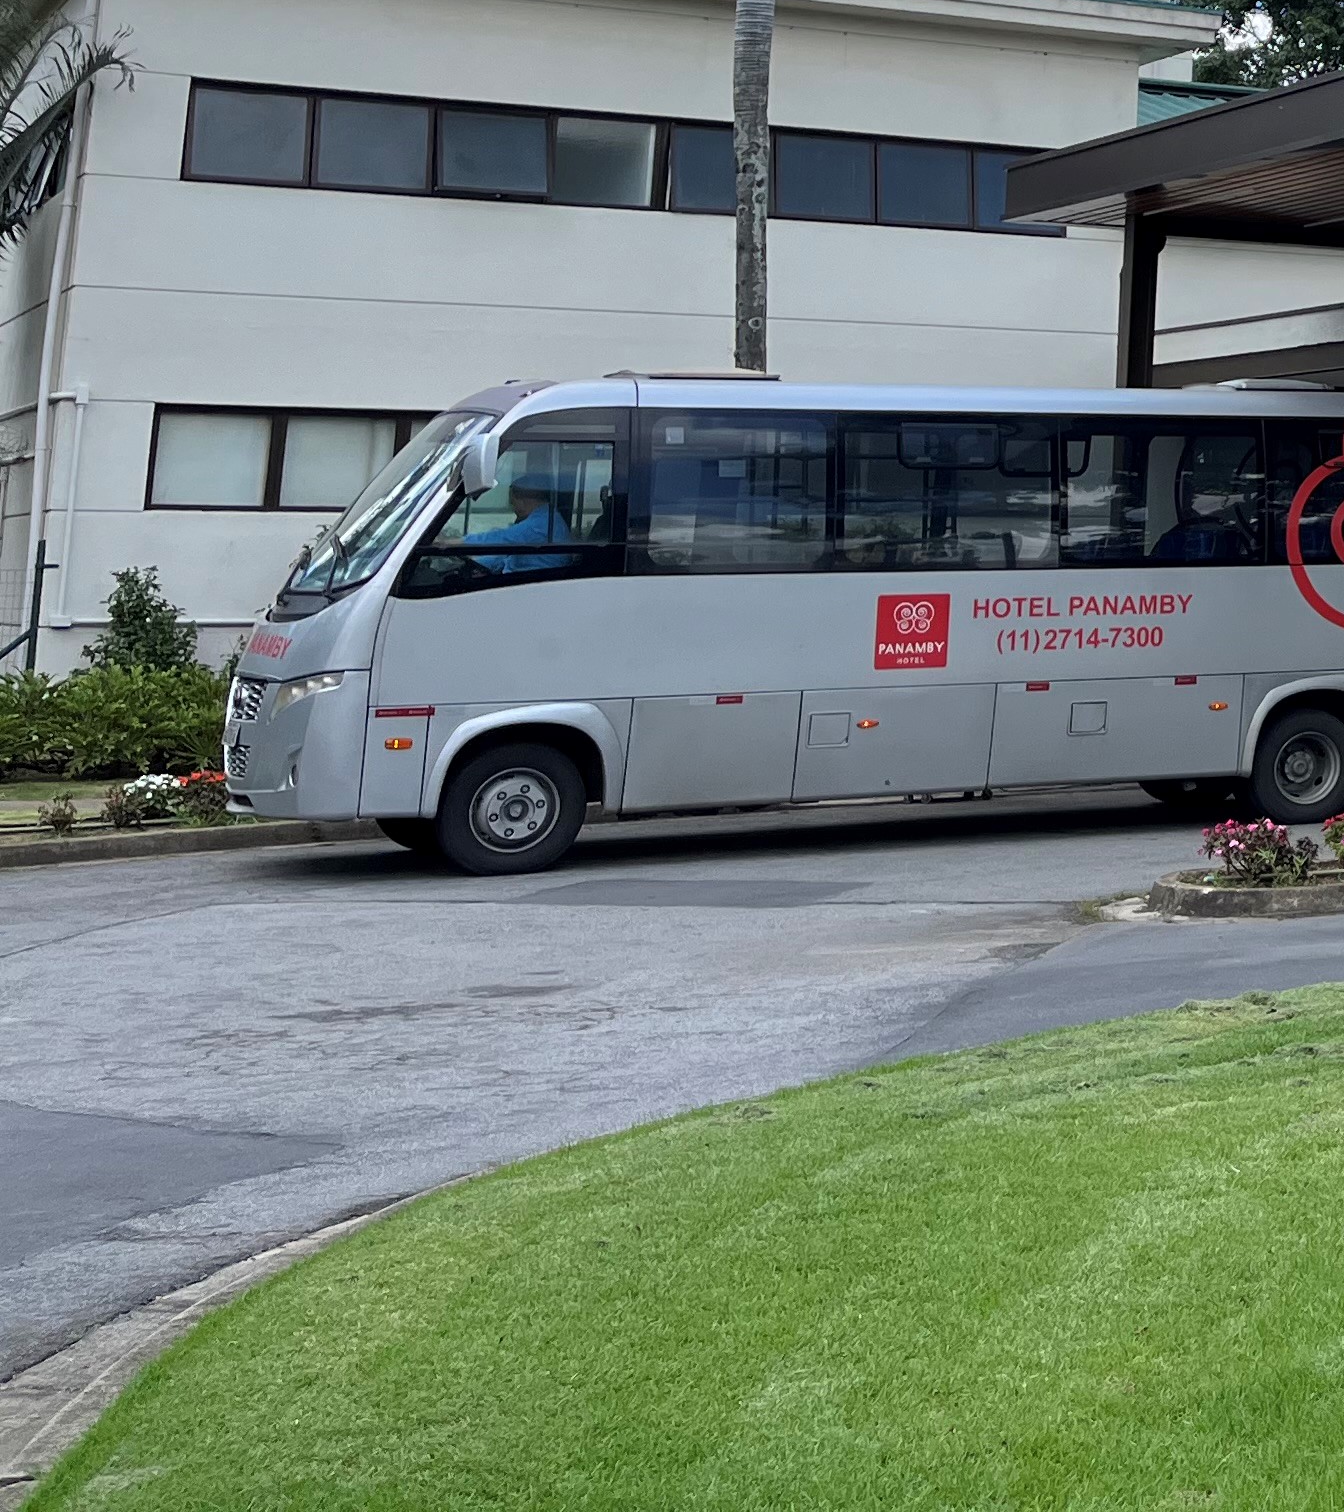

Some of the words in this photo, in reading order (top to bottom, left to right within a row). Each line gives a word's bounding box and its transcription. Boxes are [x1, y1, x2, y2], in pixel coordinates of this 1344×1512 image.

[972, 597, 1060, 619] HOTEL
[1068, 594, 1193, 615] PANAMBY
[249, 633, 293, 659] ANAMBY
[878, 641, 945, 655] PANAMBY
[896, 656, 925, 664] HOTEL
